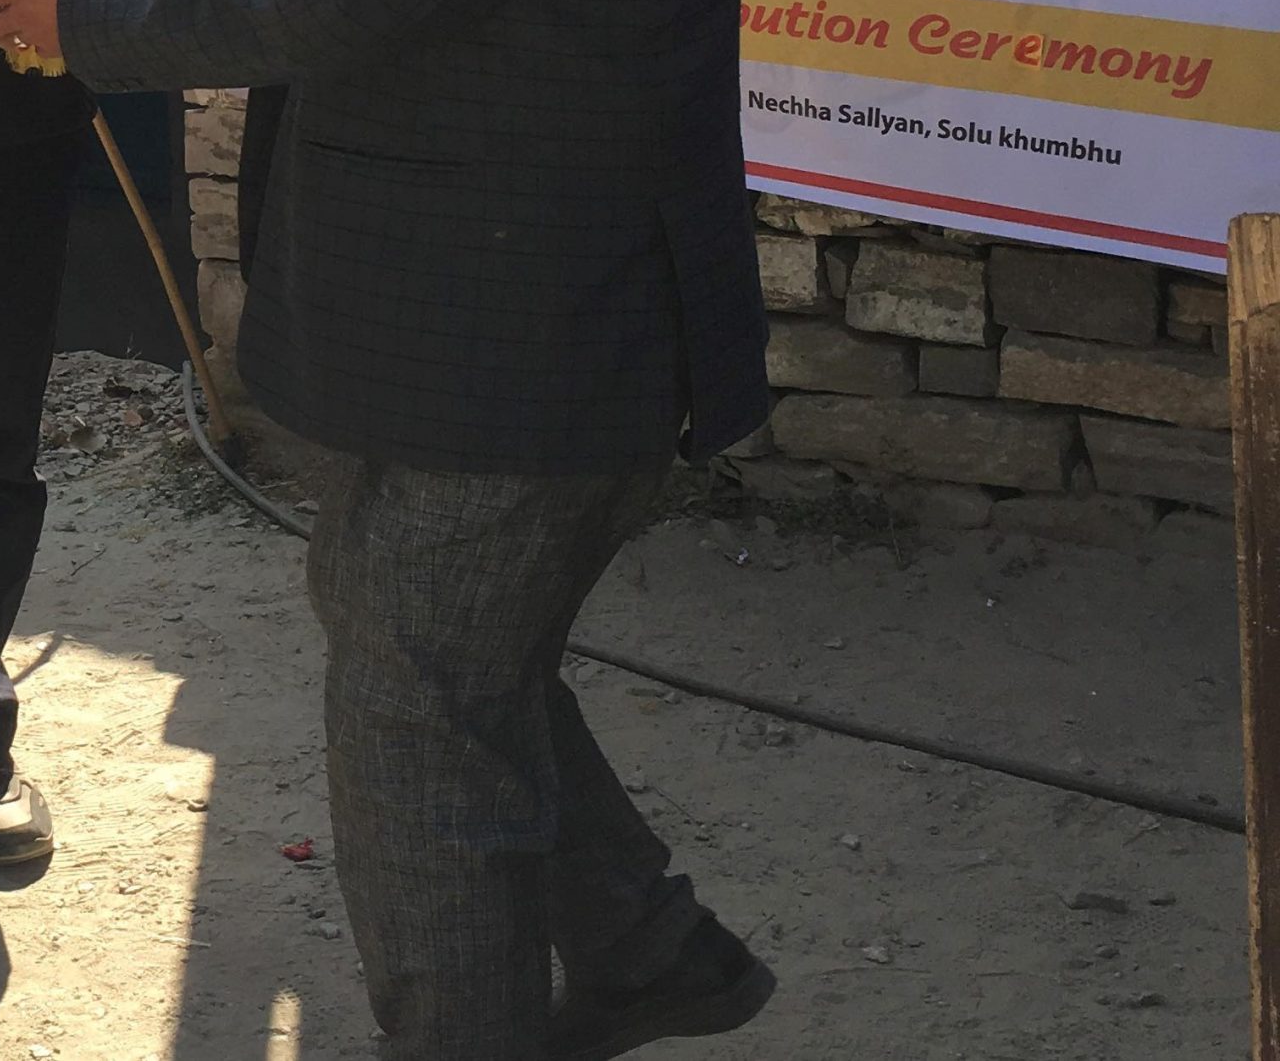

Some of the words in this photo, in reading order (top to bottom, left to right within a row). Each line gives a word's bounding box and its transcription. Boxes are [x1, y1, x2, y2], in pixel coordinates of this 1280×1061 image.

[907, 13, 1214, 100] Ceremony
[748, 90, 832, 122] Nechha
[838, 103, 932, 139] Sallyan,
[937, 118, 993, 145] Solu
[998, 125, 1123, 166] khumbhu
